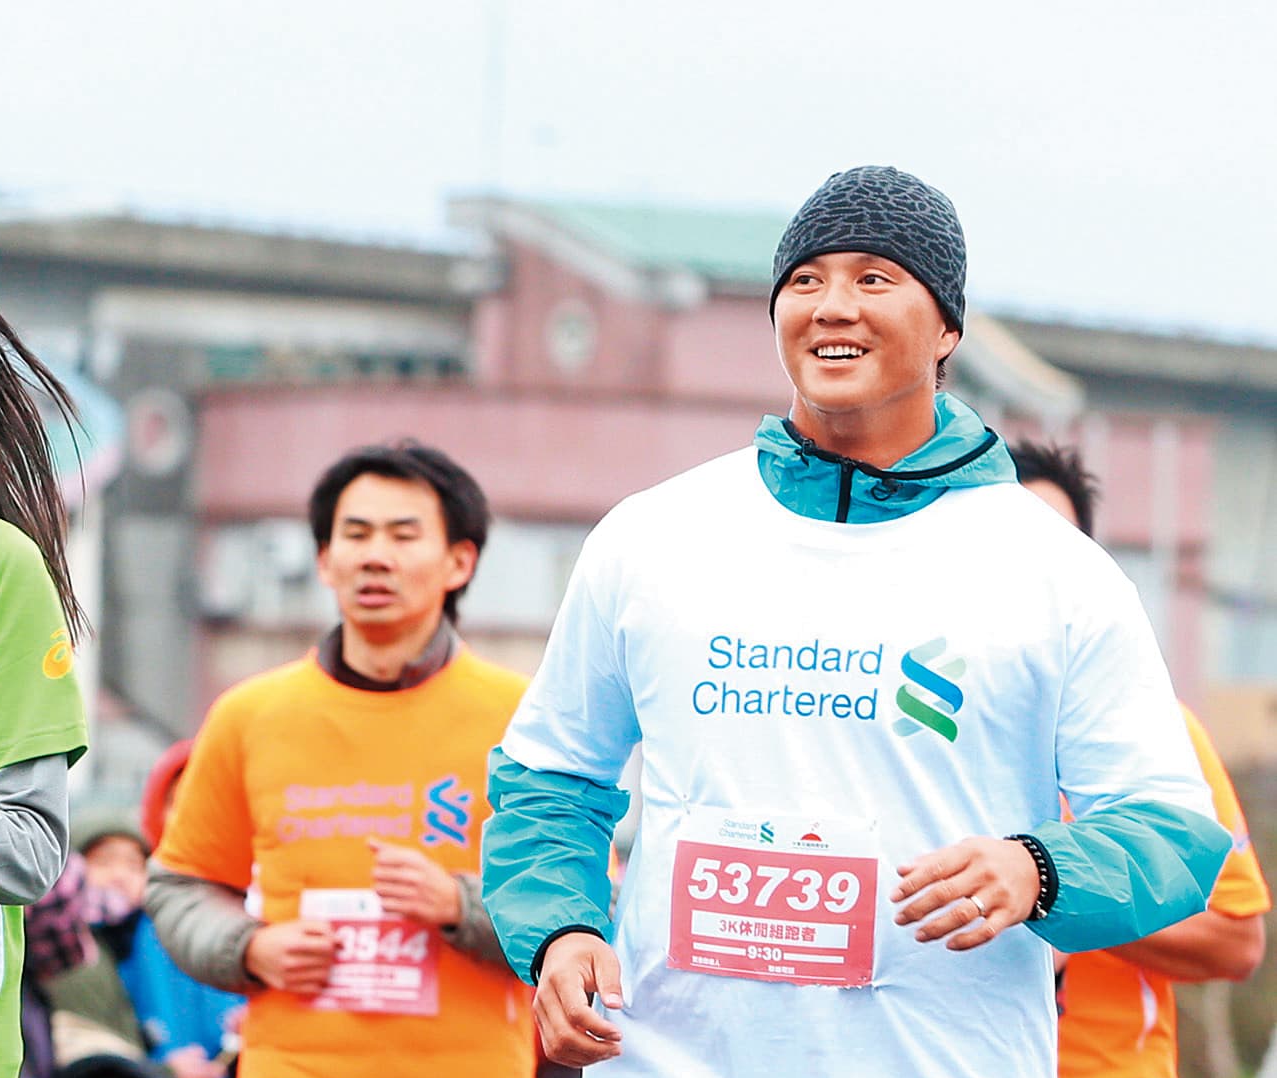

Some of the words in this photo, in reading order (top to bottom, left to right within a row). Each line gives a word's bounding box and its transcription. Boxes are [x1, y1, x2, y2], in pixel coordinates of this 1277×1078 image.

[708, 635, 884, 675] Standard
[692, 681, 879, 721] Chartered
[687, 857, 861, 914] 53739
[335, 925, 430, 963] 3544
[746, 945, 783, 962] 9:30
